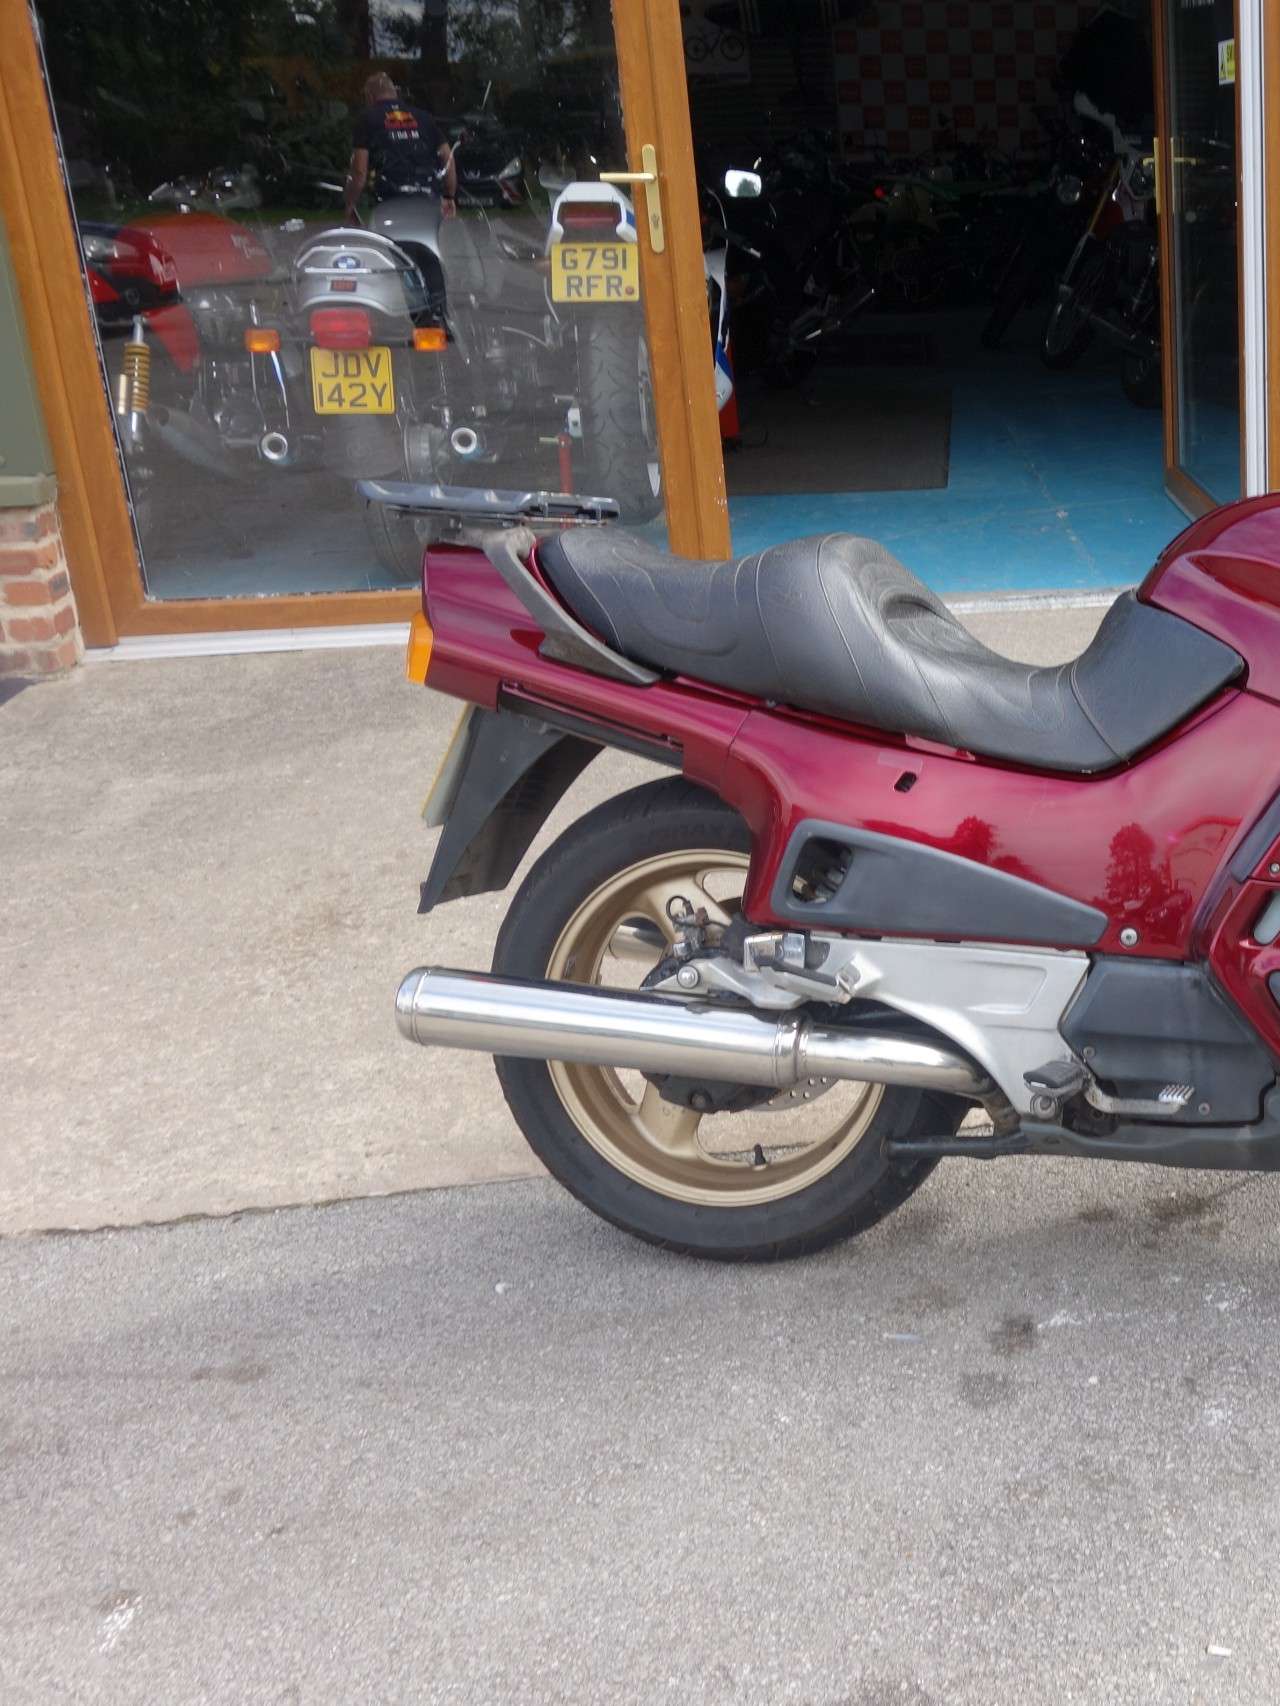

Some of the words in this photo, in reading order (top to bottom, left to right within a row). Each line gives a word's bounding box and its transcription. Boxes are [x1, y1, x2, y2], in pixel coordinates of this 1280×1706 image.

[561, 247, 627, 271] G791
[566, 275, 623, 297] RFR
[321, 350, 382, 378] JDV
[318, 382, 387, 408] 142Y
